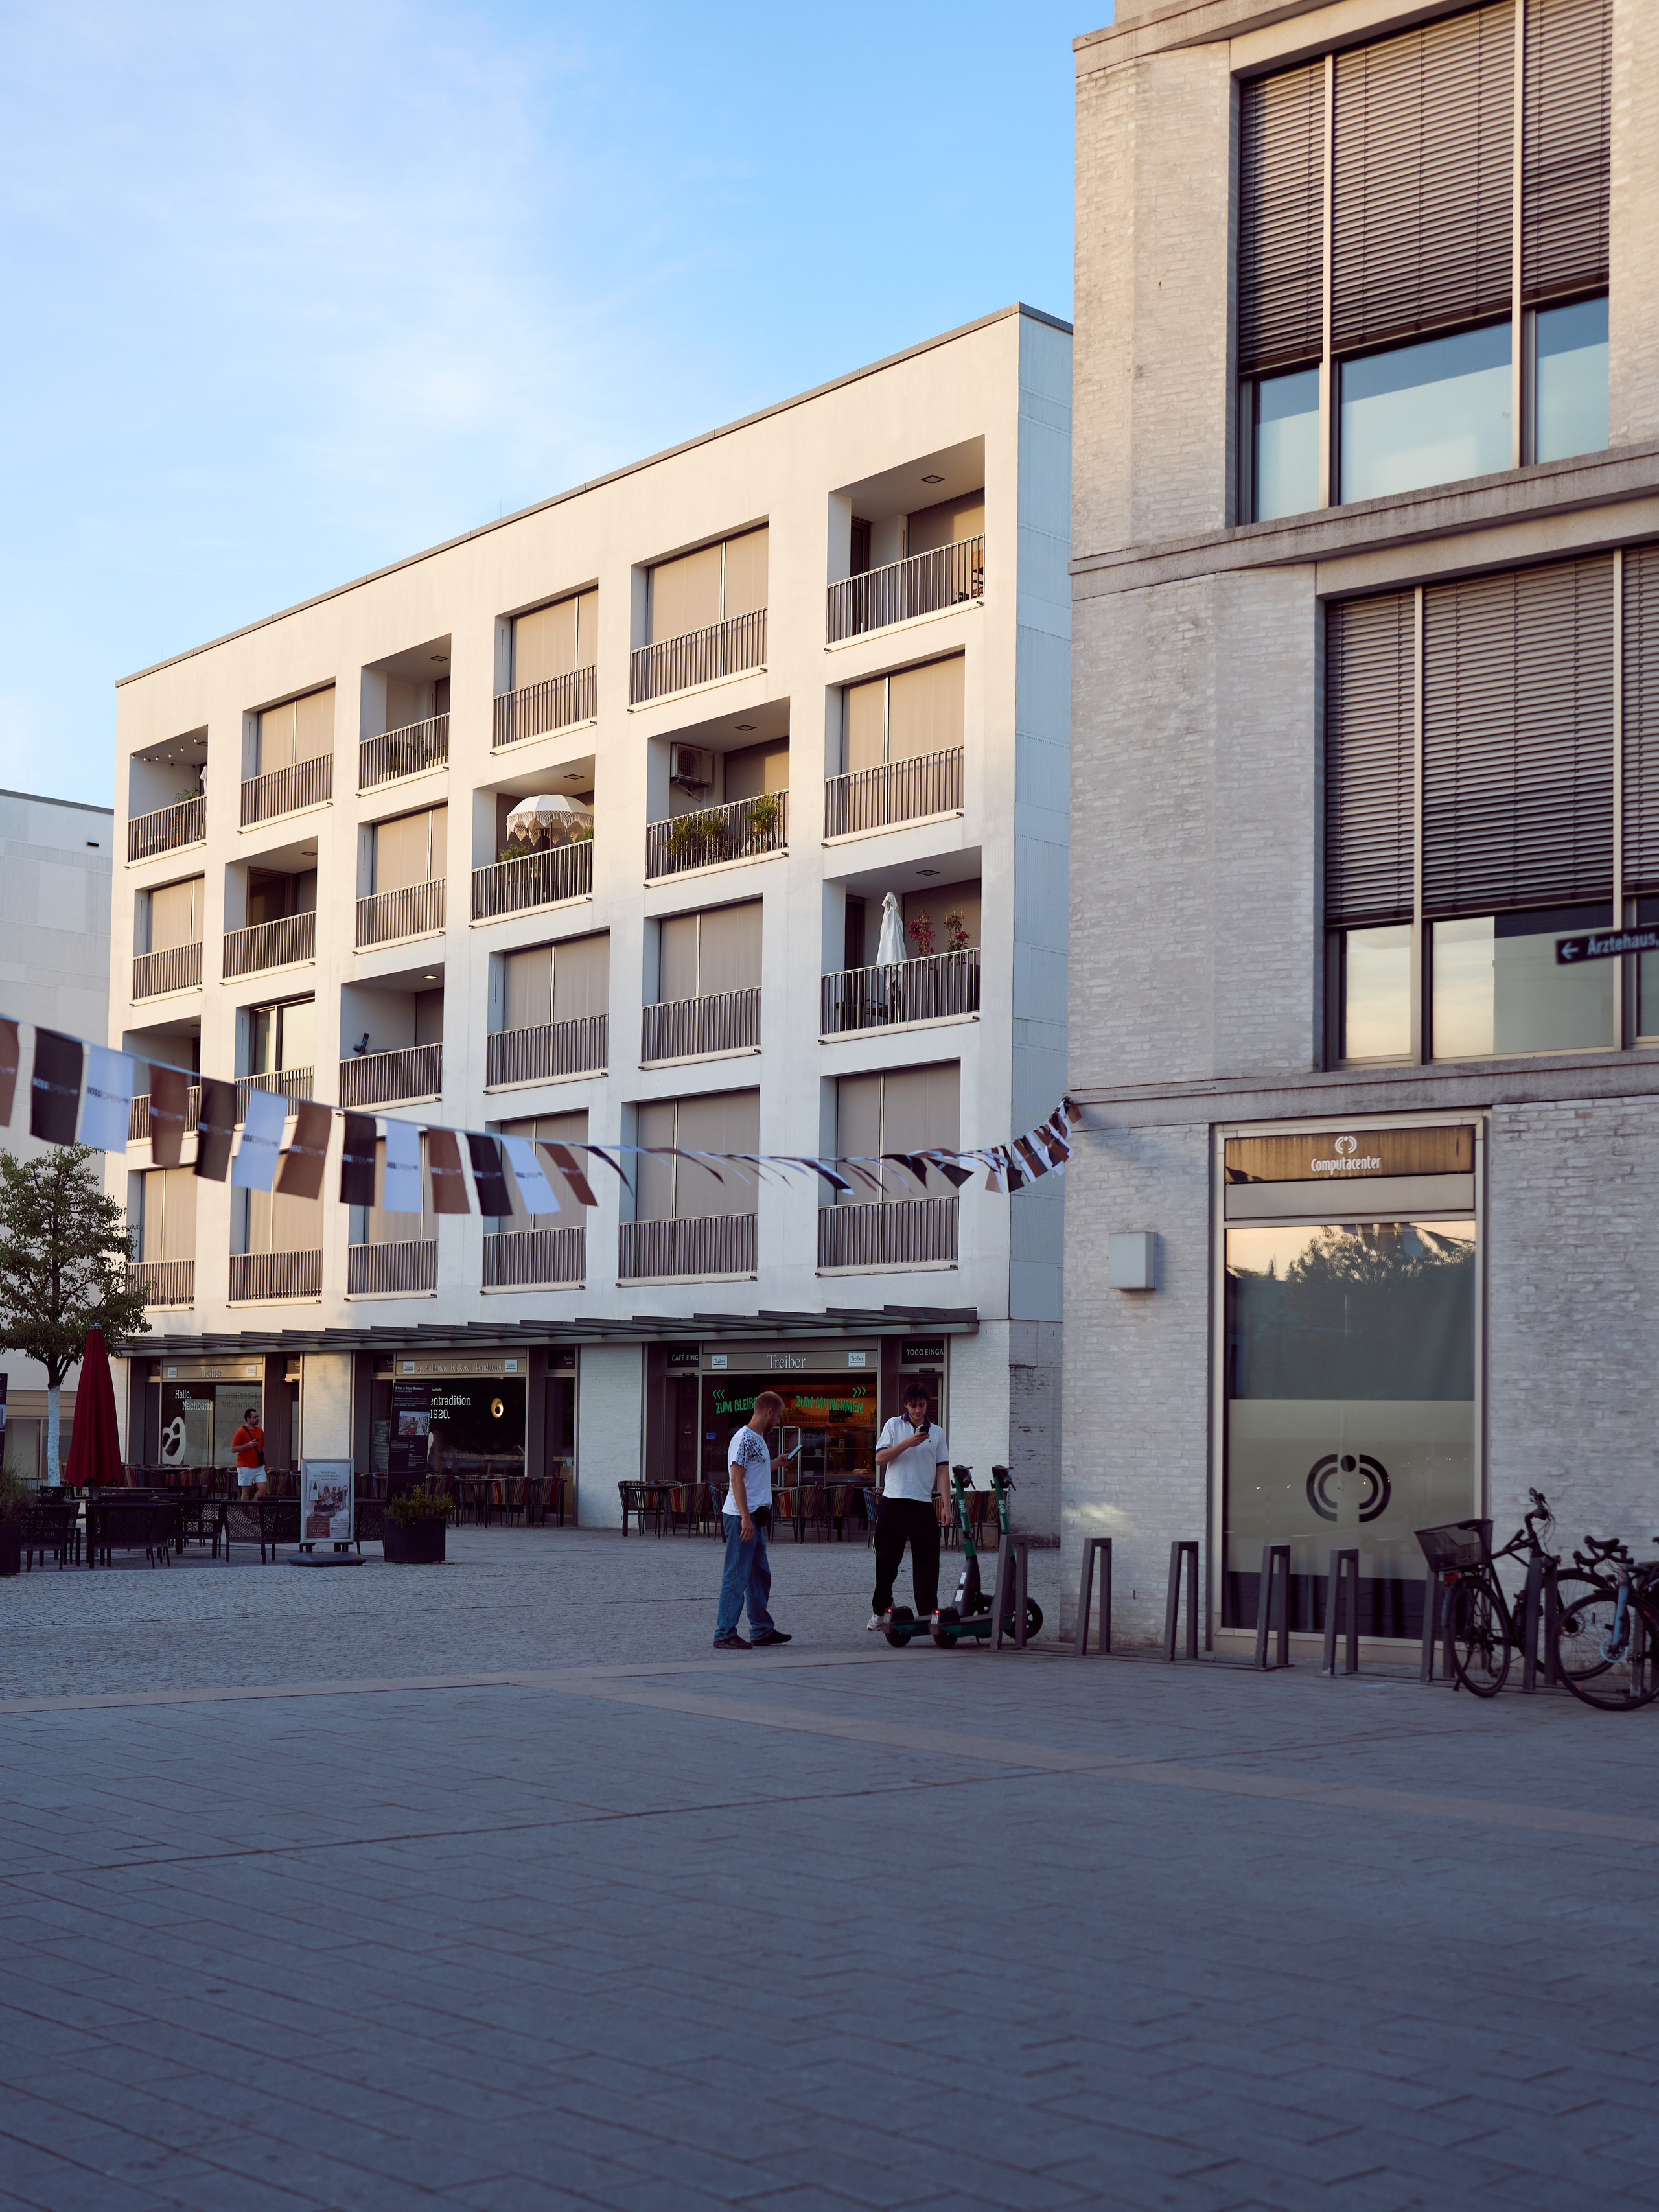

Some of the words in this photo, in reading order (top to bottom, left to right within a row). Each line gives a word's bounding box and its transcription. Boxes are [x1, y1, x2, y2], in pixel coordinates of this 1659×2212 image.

[1311, 1156, 1382, 1176] Computacenter
[476, 1362, 502, 1371] konditorei
[767, 1354, 806, 1369] Treiber
[200, 1366, 223, 1378] Treiber
[175, 1390, 192, 1399] Hallo,
[182, 1401, 213, 1410] Nachbarn!
[715, 1401, 732, 1414] ZUM
[796, 1395, 813, 1409] ZUM
[815, 1397, 863, 1414] MITNEHMEN
[430, 1409, 450, 1419] 1920.
